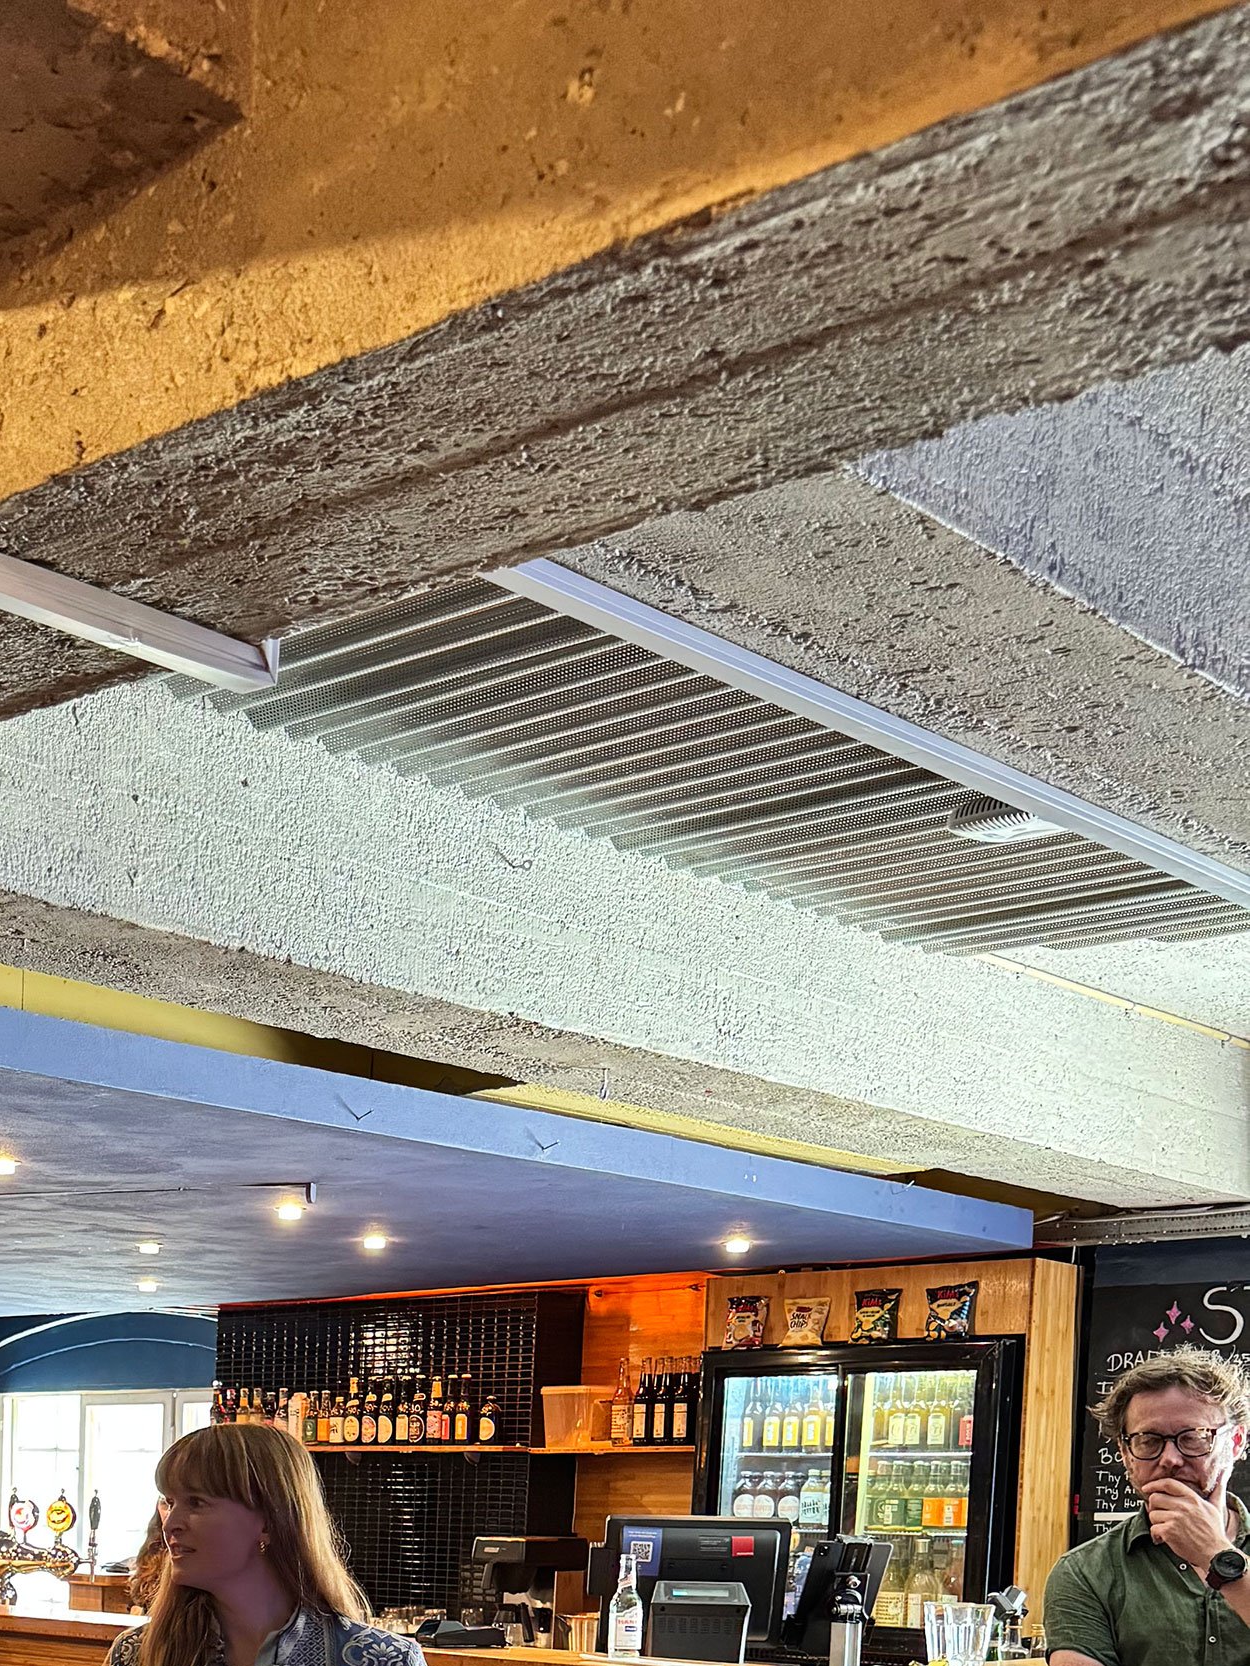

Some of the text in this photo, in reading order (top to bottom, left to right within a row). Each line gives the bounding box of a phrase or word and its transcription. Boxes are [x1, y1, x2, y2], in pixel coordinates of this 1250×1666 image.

[1096, 1471, 1121, 1488] Thy
[1096, 1486, 1119, 1500] Thy
[1095, 1499, 1116, 1512] Thy
